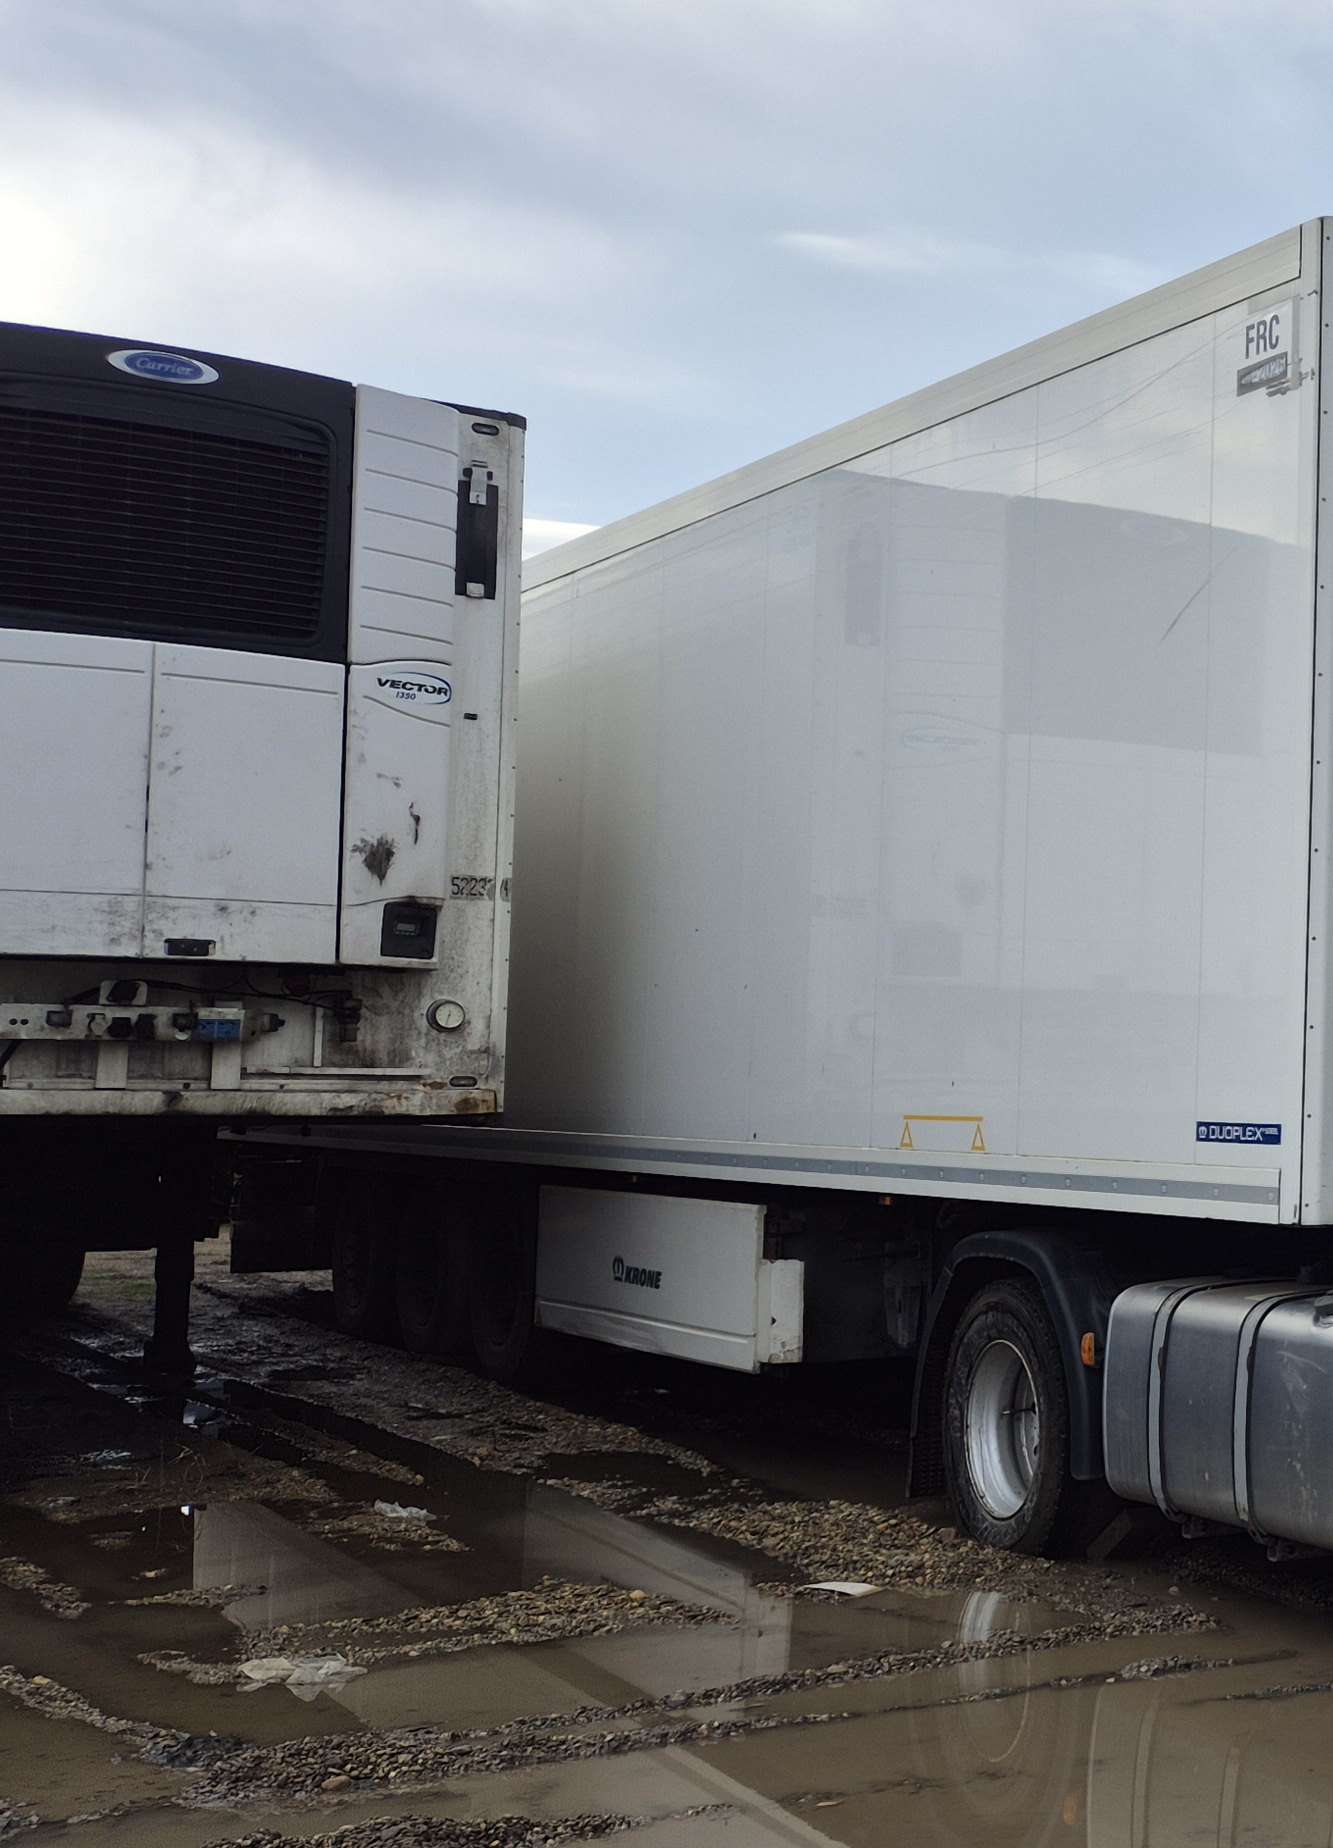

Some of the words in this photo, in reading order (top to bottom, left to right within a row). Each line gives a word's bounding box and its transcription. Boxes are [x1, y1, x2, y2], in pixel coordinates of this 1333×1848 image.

[1245, 314, 1280, 360] FRC
[135, 357, 194, 376] Carrier
[376, 677, 449, 697] VECTOR
[395, 691, 417, 700] 1350
[1209, 1125, 1263, 1141] DUOPLEX
[624, 1265, 662, 1290] KRONE
